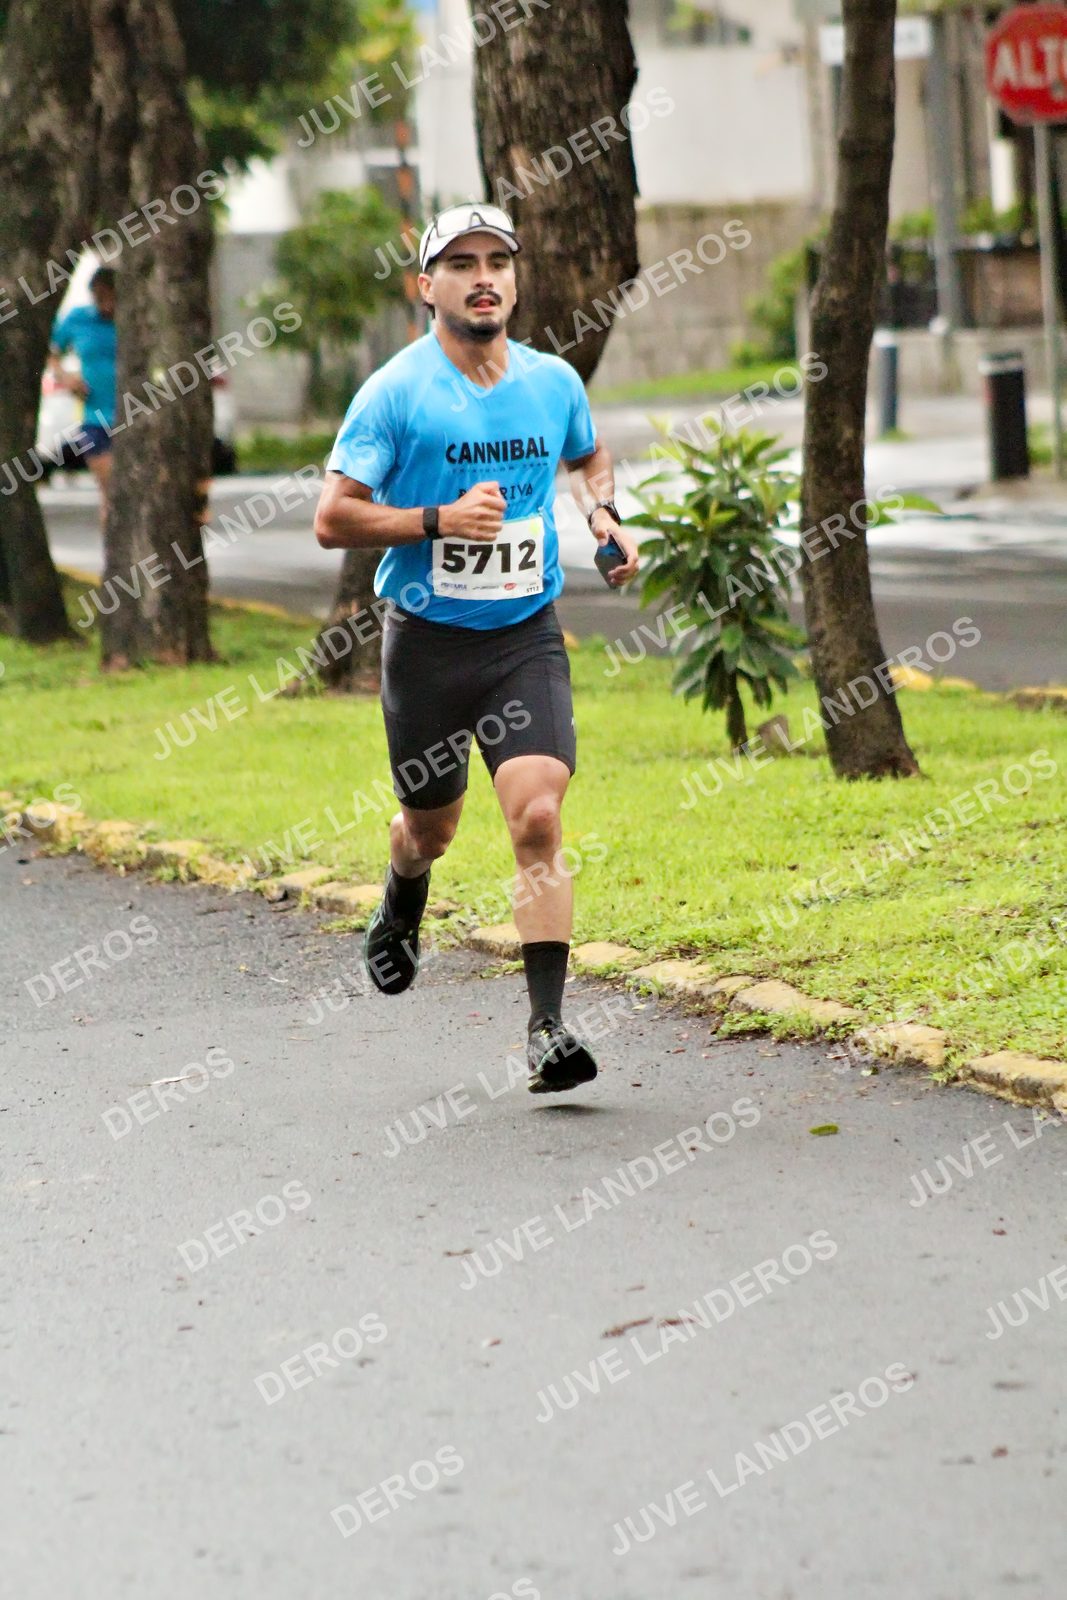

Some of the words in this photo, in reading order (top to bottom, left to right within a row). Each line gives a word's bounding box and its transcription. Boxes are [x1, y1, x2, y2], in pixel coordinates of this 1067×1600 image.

[993, 37, 1067, 91] ALT
[446, 436, 549, 465] CANNIBAL
[441, 539, 536, 574] 5712
